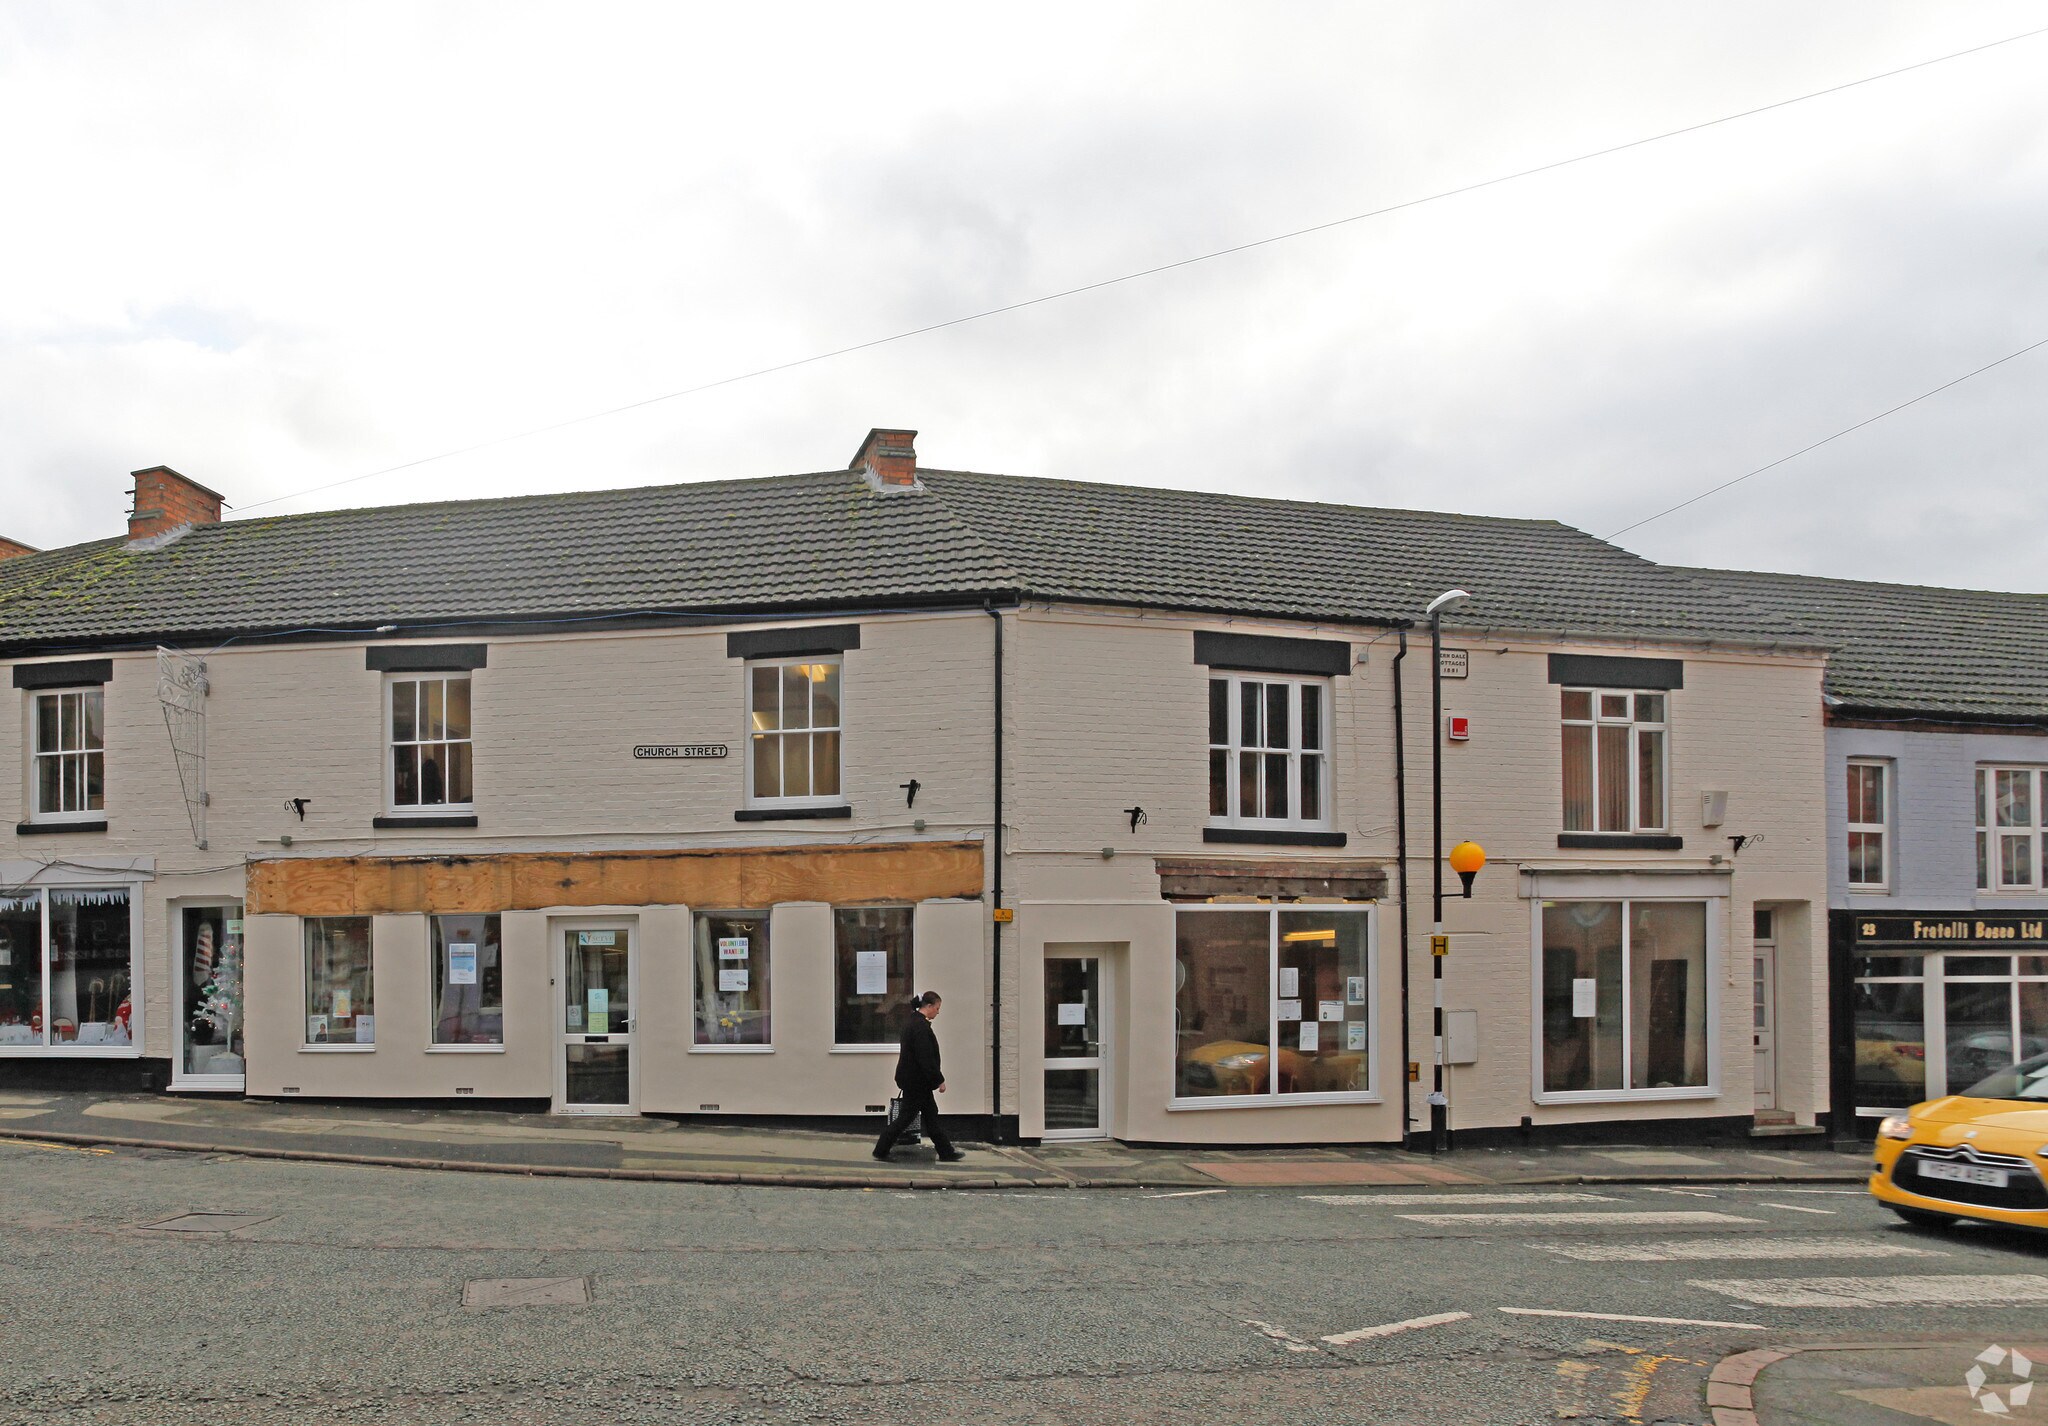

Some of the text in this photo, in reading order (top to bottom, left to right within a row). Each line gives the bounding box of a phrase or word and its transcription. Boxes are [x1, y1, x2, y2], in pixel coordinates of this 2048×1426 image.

[637, 747, 724, 756] CHURCH STREET
[1861, 923, 1876, 936] 23
[1913, 921, 1969, 939] Fratelli
[2021, 921, 2043, 939] Ltd
[1433, 937, 1446, 954] H
